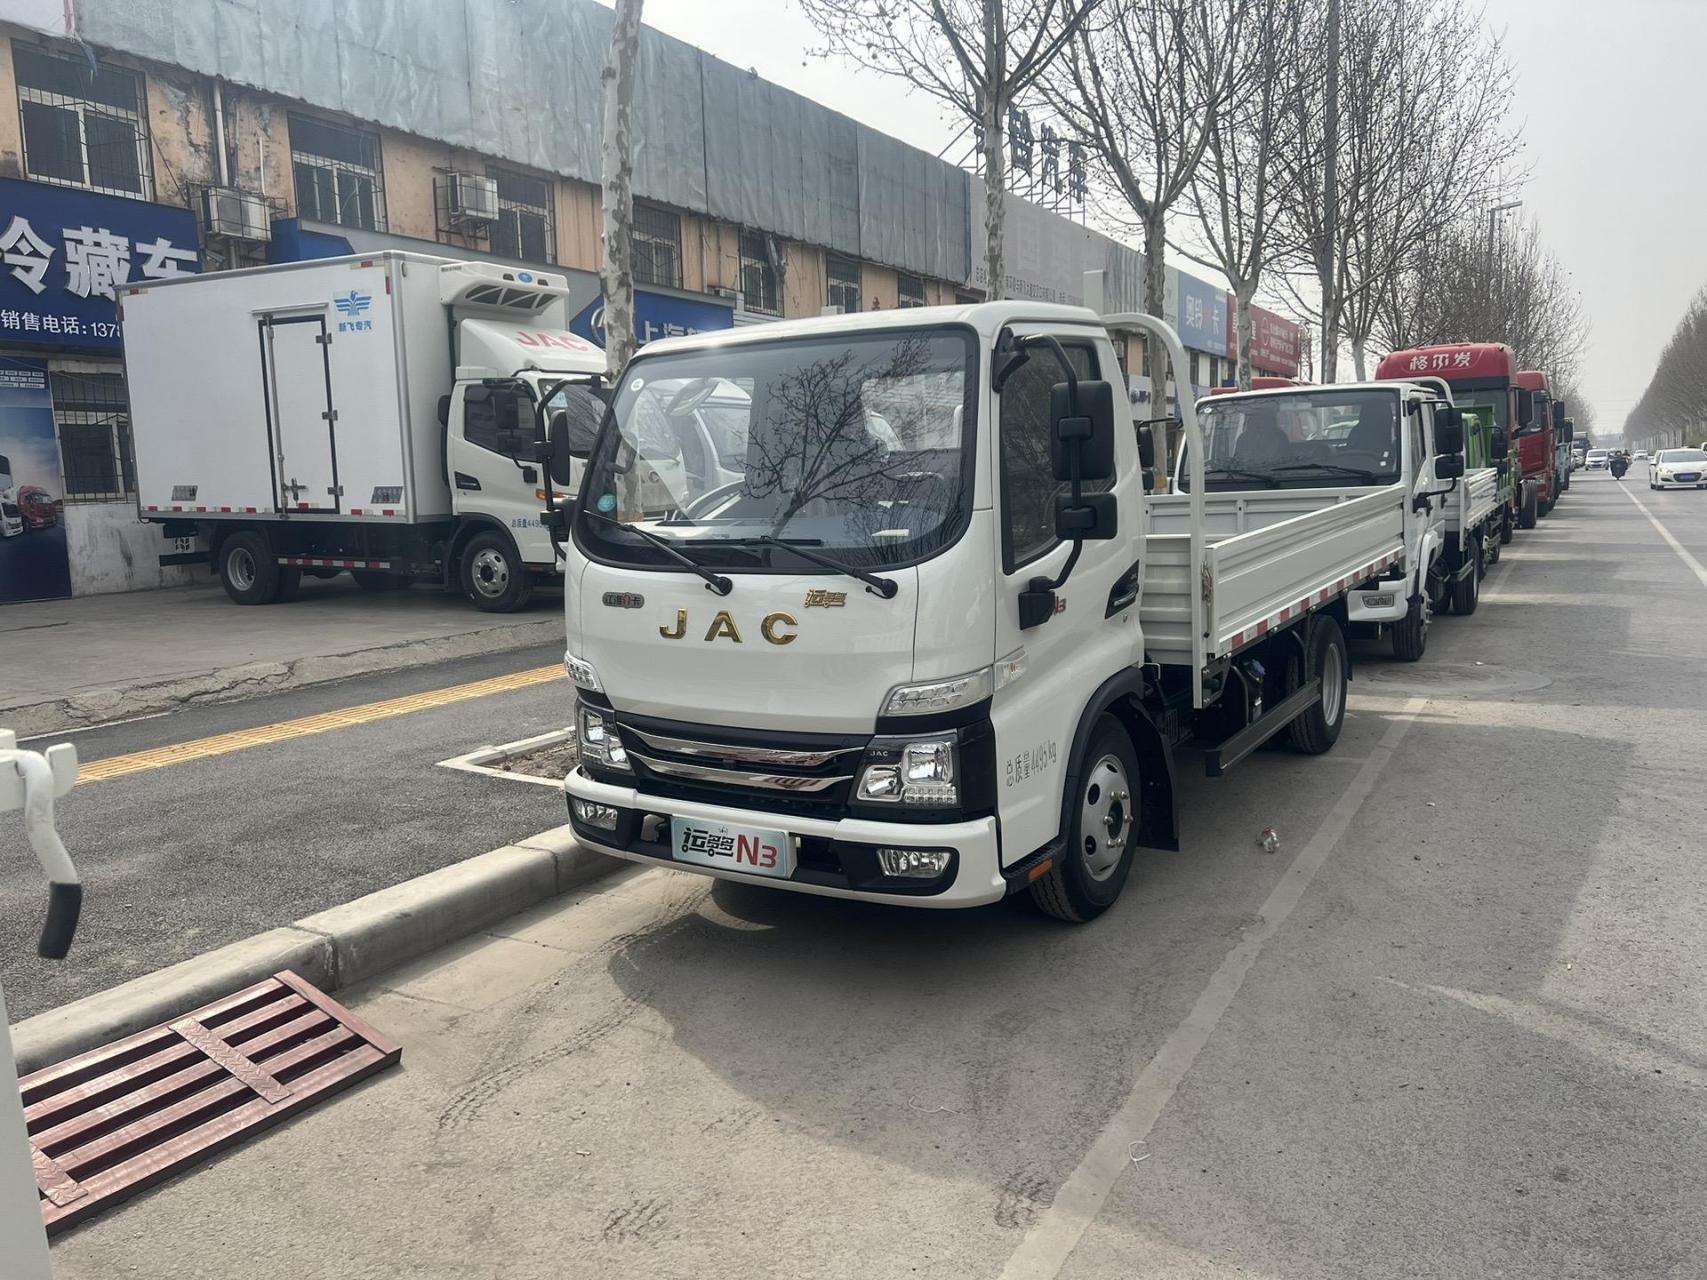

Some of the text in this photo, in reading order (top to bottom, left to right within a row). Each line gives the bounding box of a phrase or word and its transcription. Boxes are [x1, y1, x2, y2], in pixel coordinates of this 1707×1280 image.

[515, 330, 589, 352] JAC
[1409, 351, 1471, 371] 格尔发
[659, 607, 799, 646] JAC
